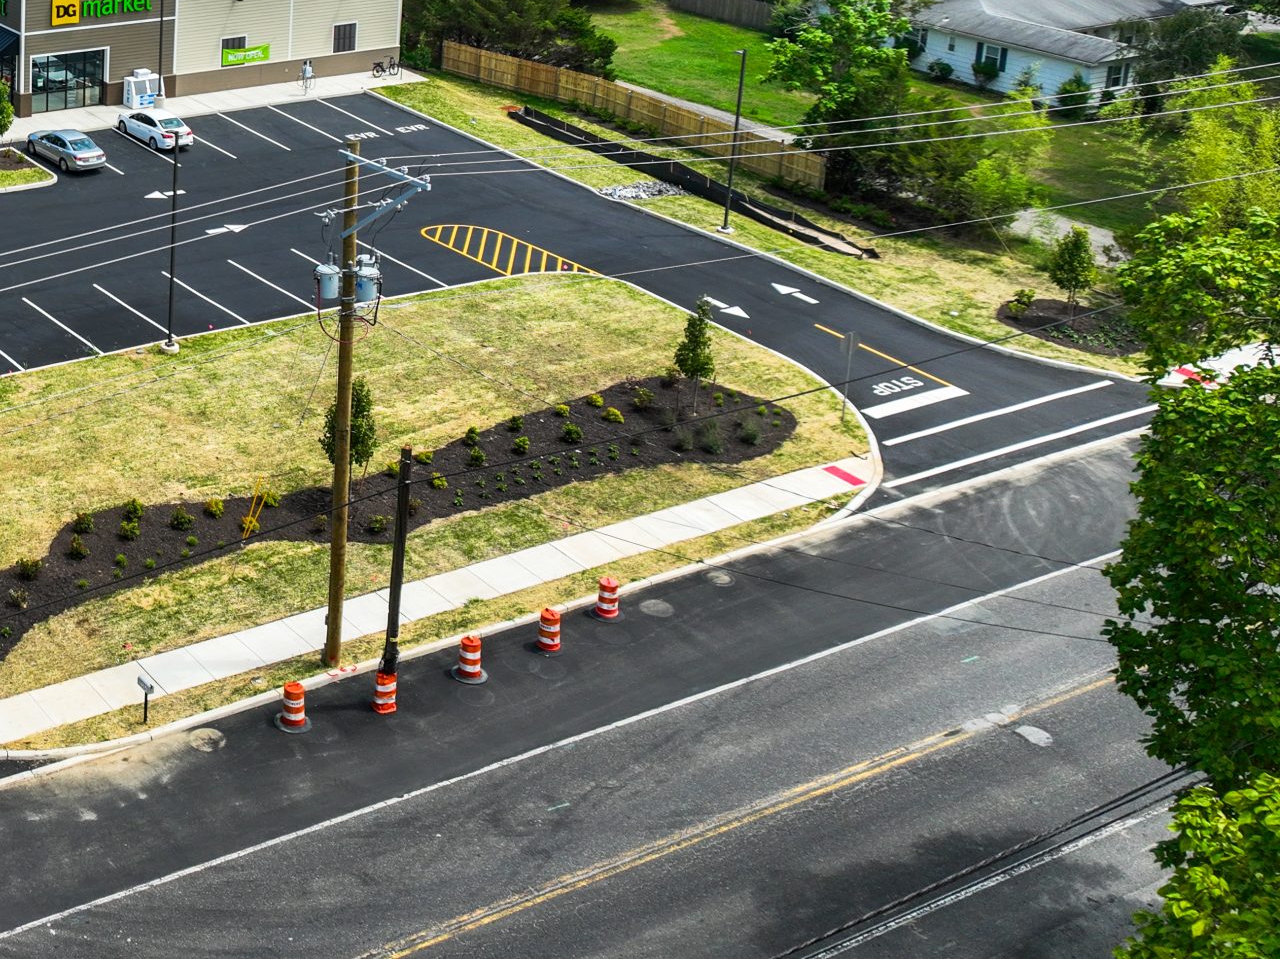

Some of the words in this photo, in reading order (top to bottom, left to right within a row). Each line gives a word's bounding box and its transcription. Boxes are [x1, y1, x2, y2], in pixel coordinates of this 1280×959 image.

[55, 4, 77, 18] DG
[228, 52, 245, 61] NOW
[871, 376, 924, 396] STOP
